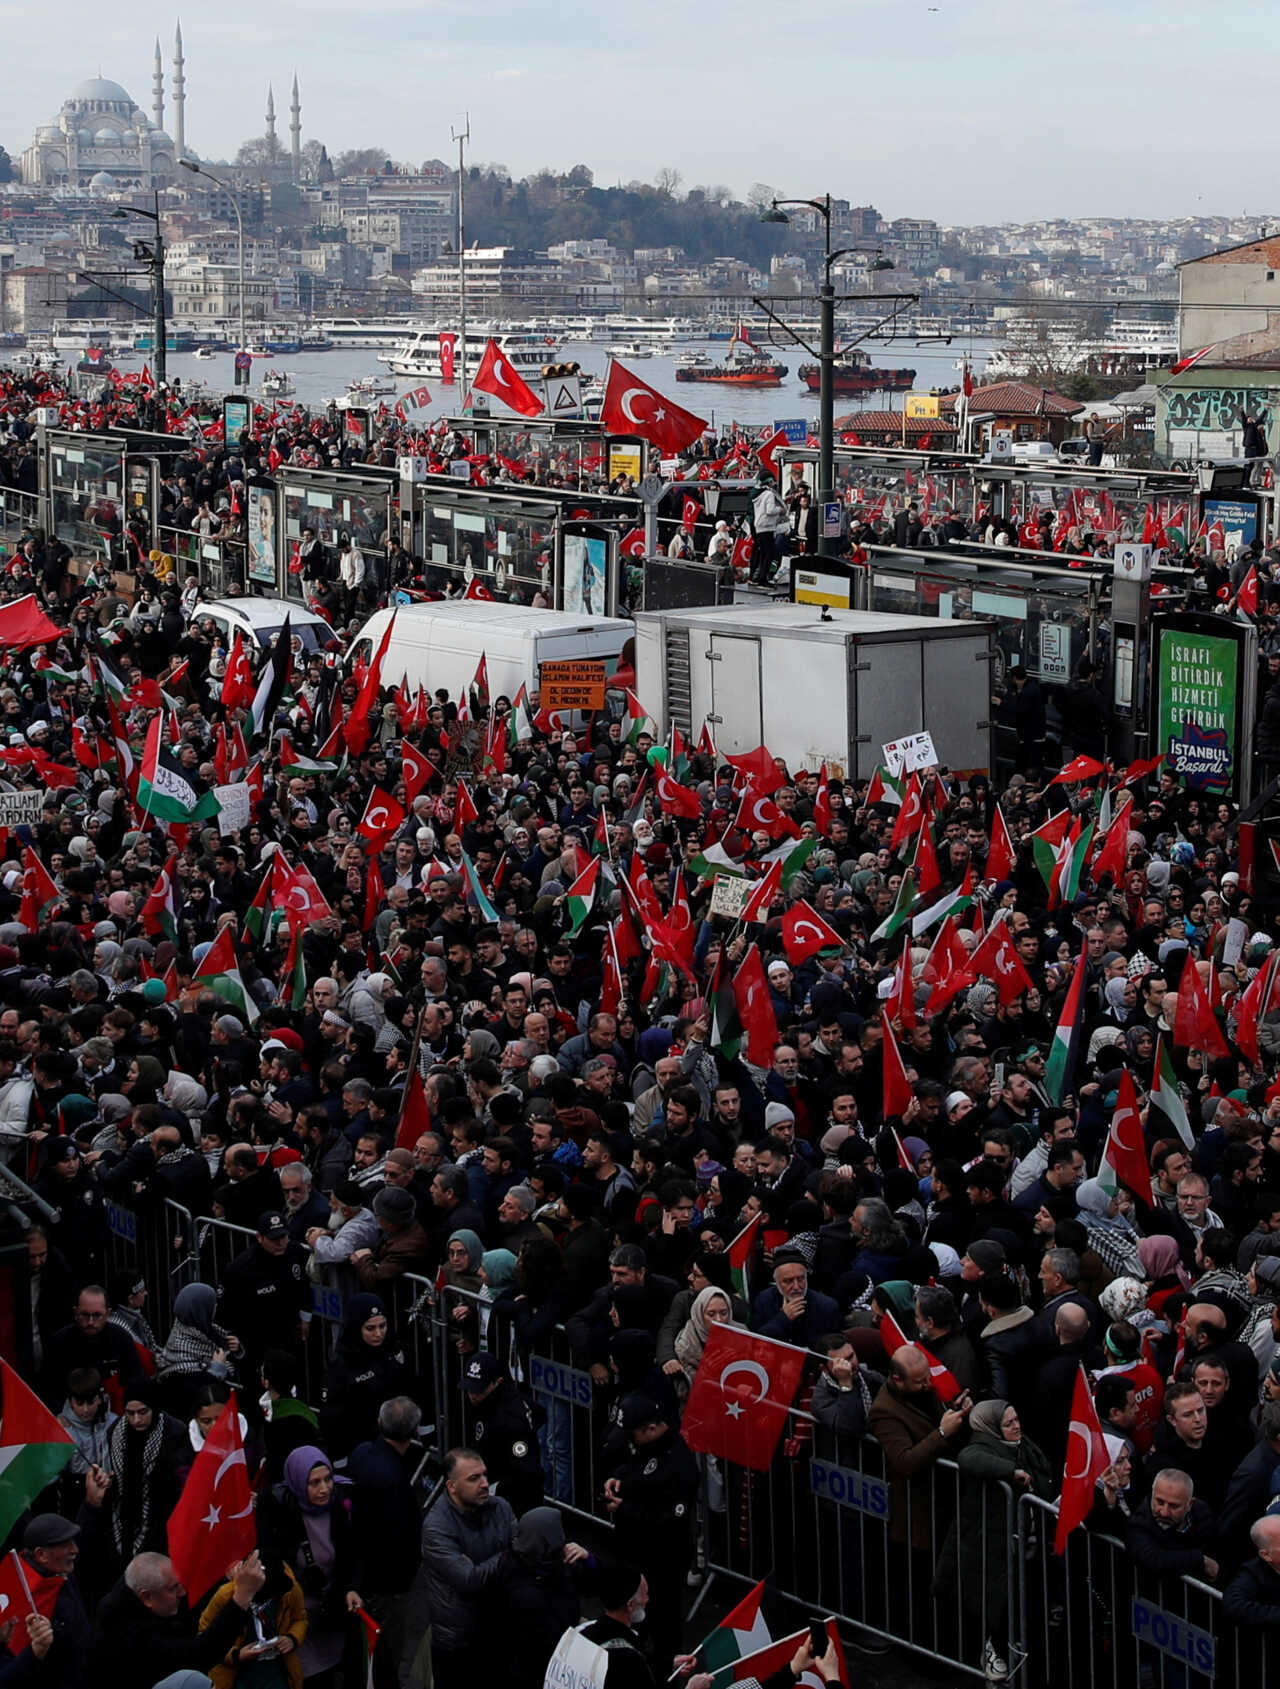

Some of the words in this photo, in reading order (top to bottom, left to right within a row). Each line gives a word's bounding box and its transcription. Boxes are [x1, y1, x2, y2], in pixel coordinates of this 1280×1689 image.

[1171, 666, 1223, 687] BİTİRDİK
[1171, 686, 1219, 707] HİZMETİ
[1171, 707, 1225, 728] GETİRDİK
[1170, 739, 1229, 762] İSTANBUL
